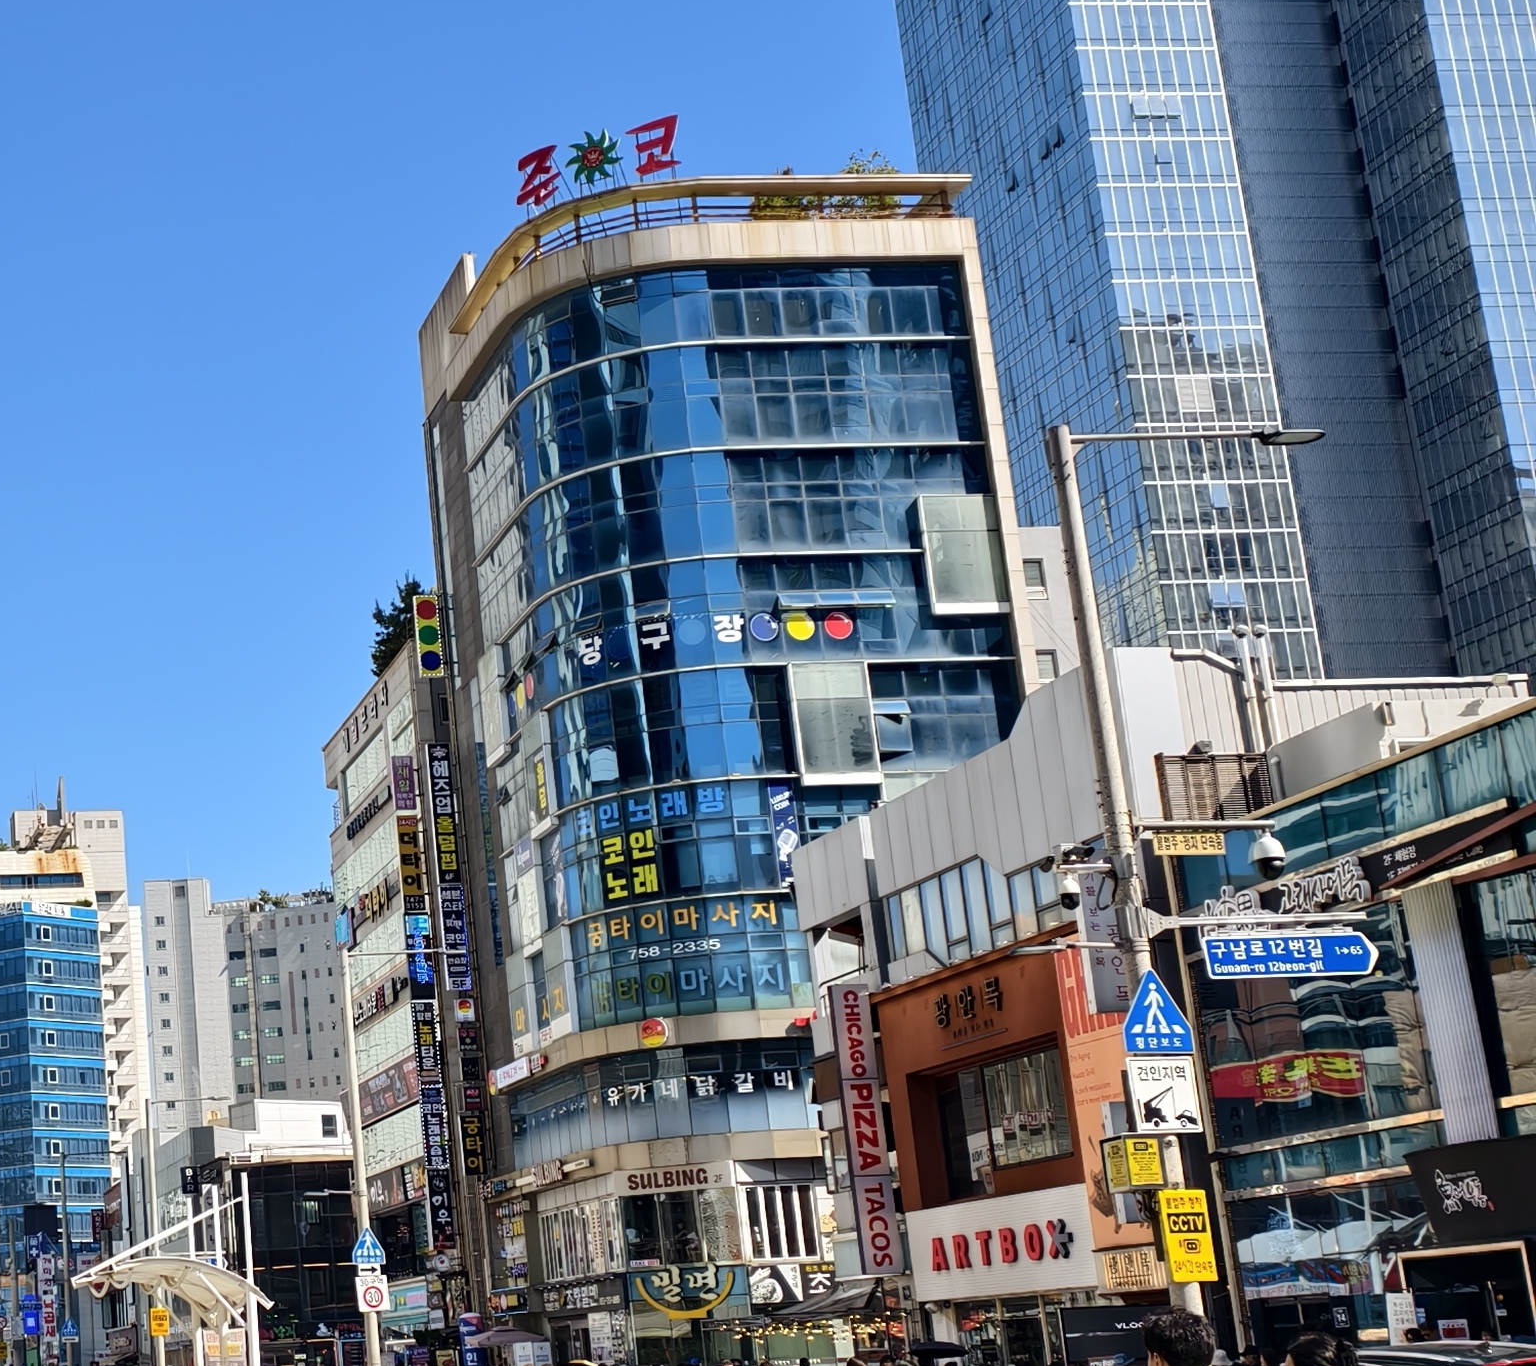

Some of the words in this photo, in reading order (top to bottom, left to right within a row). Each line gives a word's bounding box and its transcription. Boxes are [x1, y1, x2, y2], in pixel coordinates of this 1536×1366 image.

[432, 760, 453, 814] 헤즈업
[577, 786, 726, 836] 코인노래방
[400, 831, 422, 891] 더타이
[436, 815, 458, 871] 홀덤펍
[602, 829, 656, 866] 코인
[606, 862, 660, 901] 노래
[1278, 857, 1365, 914] 고래사어묵
[445, 933, 466, 944] 코인
[627, 937, 721, 962] 758-2335
[1350, 944, 1363, 956] 65
[1213, 962, 1266, 974] Gunam-ro
[1268, 961, 1324, 976] 12beon-gil
[932, 976, 1003, 1029] 광안목
[843, 988, 867, 1078] CHICAGO
[1134, 1036, 1185, 1050] 횡단보도
[1136, 1063, 1188, 1083] 견인지역
[463, 1117, 484, 1174] 궁타이
[850, 1080, 882, 1172] PIZZA
[185, 1167, 196, 1193] BAR
[531, 1160, 563, 1188] SULBING
[627, 1167, 709, 1191] SULBING
[713, 1174, 724, 1184] 2F
[865, 1182, 895, 1268] TACOS
[1169, 1214, 1203, 1232] CCTV
[930, 1219, 1071, 1273] ARTBOX
[368, 1290, 380, 1304] 30
[651, 1263, 719, 1303] 밀면
